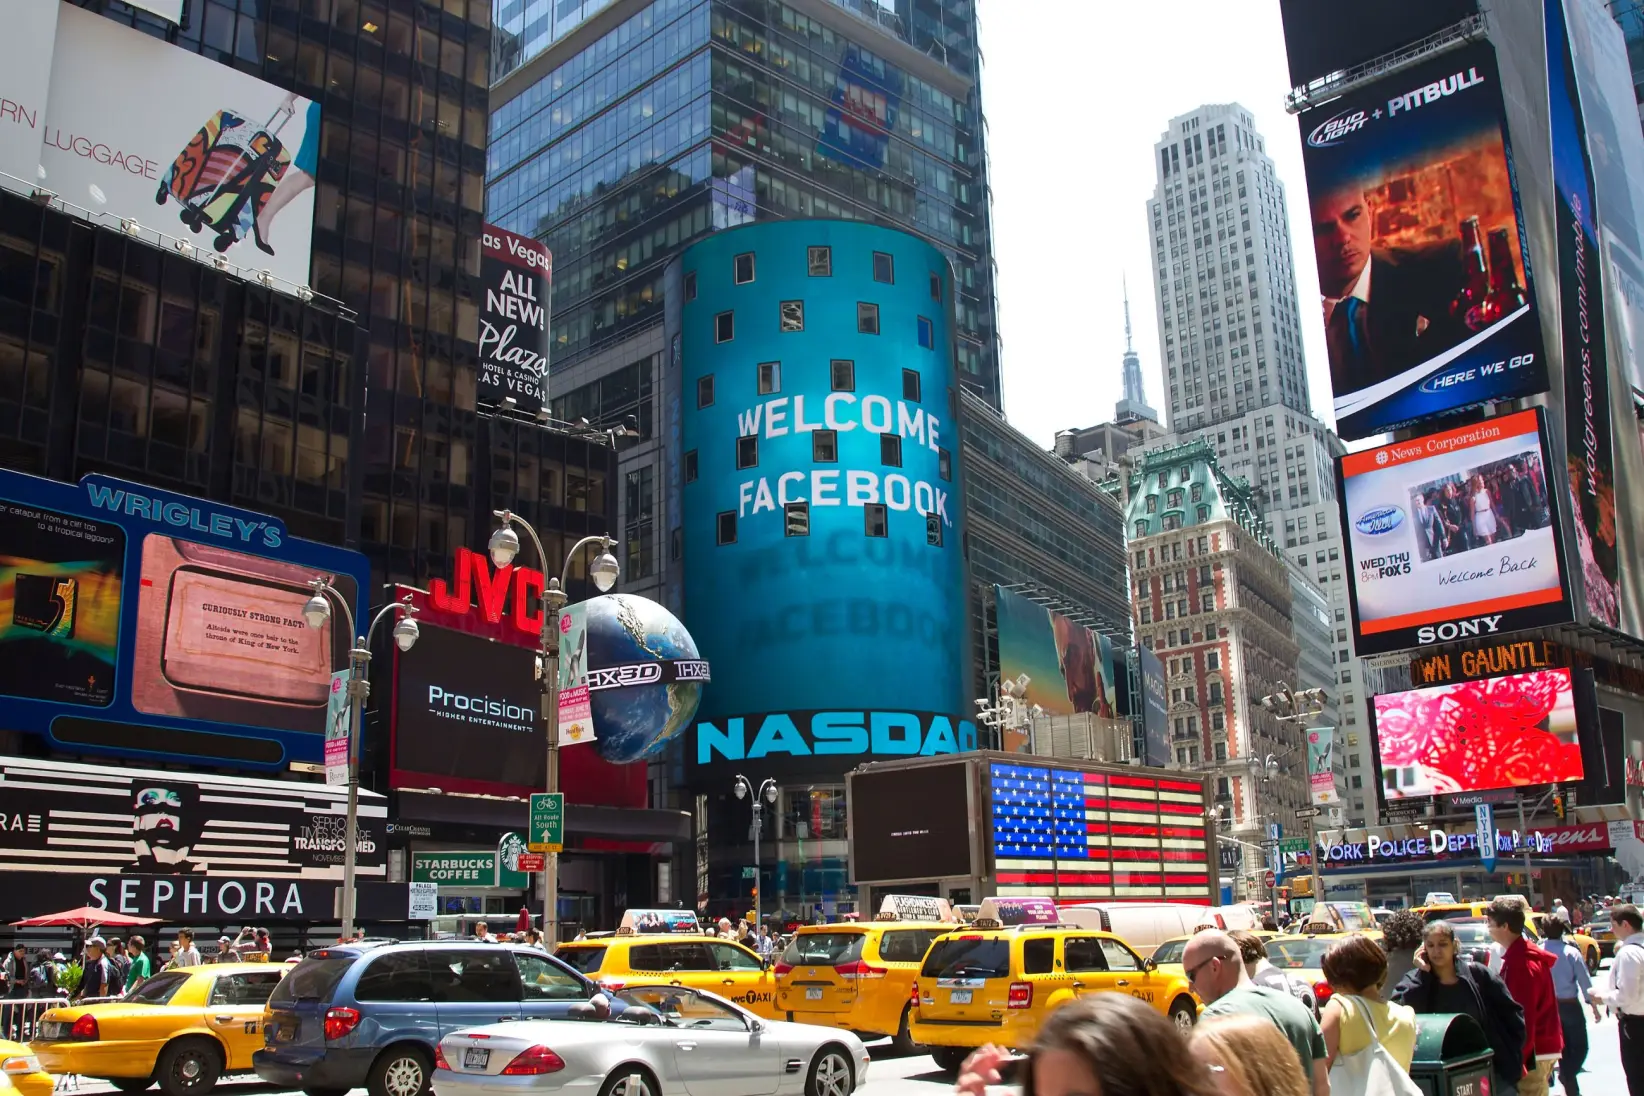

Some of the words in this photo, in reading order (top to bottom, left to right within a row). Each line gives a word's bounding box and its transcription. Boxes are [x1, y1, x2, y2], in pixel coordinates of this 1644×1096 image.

[1388, 66, 1485, 118] PITBULL
[1316, 117, 1369, 145] LIGHT
[1324, 111, 1366, 133] BUD
[0, 98, 37, 129] RN
[44, 125, 159, 181] LUGGAGE
[482, 233, 502, 250] as
[506, 235, 549, 271] Vegas
[500, 269, 537, 302] ALL
[487, 288, 545, 332] NEW!
[478, 318, 549, 379] Plaza
[482, 362, 505, 376] HOTEL
[514, 371, 540, 385] CASINO
[1433, 369, 1476, 390] HERE
[1480, 361, 1505, 377] WE
[1509, 353, 1534, 369] GO
[477, 371, 500, 387] AS
[507, 377, 547, 403] VEGAS
[737, 391, 940, 454] WELCOME
[1391, 444, 1423, 462] News
[1426, 426, 1501, 453] Corporation
[43, 513, 61, 524] from
[84, 521, 97, 532] top
[86, 482, 282, 548] WRIGLEY'S
[37, 522, 45, 530] to
[55, 526, 83, 538] tropical
[1379, 564, 1402, 579] FOX
[1402, 562, 1411, 574] 5
[1439, 567, 1494, 586] Welcome
[1499, 555, 1538, 576] Back
[429, 547, 545, 635] JVC
[202, 603, 248, 618] CURIOUSLY
[249, 611, 281, 625] STRONG
[205, 632, 228, 641] throne
[238, 638, 256, 648] King
[266, 643, 281, 651] New
[232, 629, 249, 637] were
[280, 637, 287, 645] to
[288, 638, 299, 646] the
[1417, 614, 1503, 645] SONY
[428, 684, 534, 723] Procision
[436, 710, 466, 721] HIGHER
[468, 716, 527, 732] ENTERTAINMENT
[1459, 796, 1483, 804] Media
[300, 826, 328, 839] TIMES
[331, 827, 371, 841] SQARE
[312, 815, 360, 830] SEPHOA
[535, 821, 558, 829] South
[1479, 806, 1491, 857] NYPD
[294, 837, 376, 853] TRANSFOMED
[1319, 838, 1363, 861] YORK
[1367, 835, 1426, 859] POLICE
[1430, 829, 1476, 854] DEPT
[415, 858, 494, 870] STARBUCKS
[429, 869, 479, 880] COFFEE
[88, 878, 304, 915] SEPHORA
[745, 990, 771, 1004] TAXI
[1456, 1083, 1473, 1096] START
